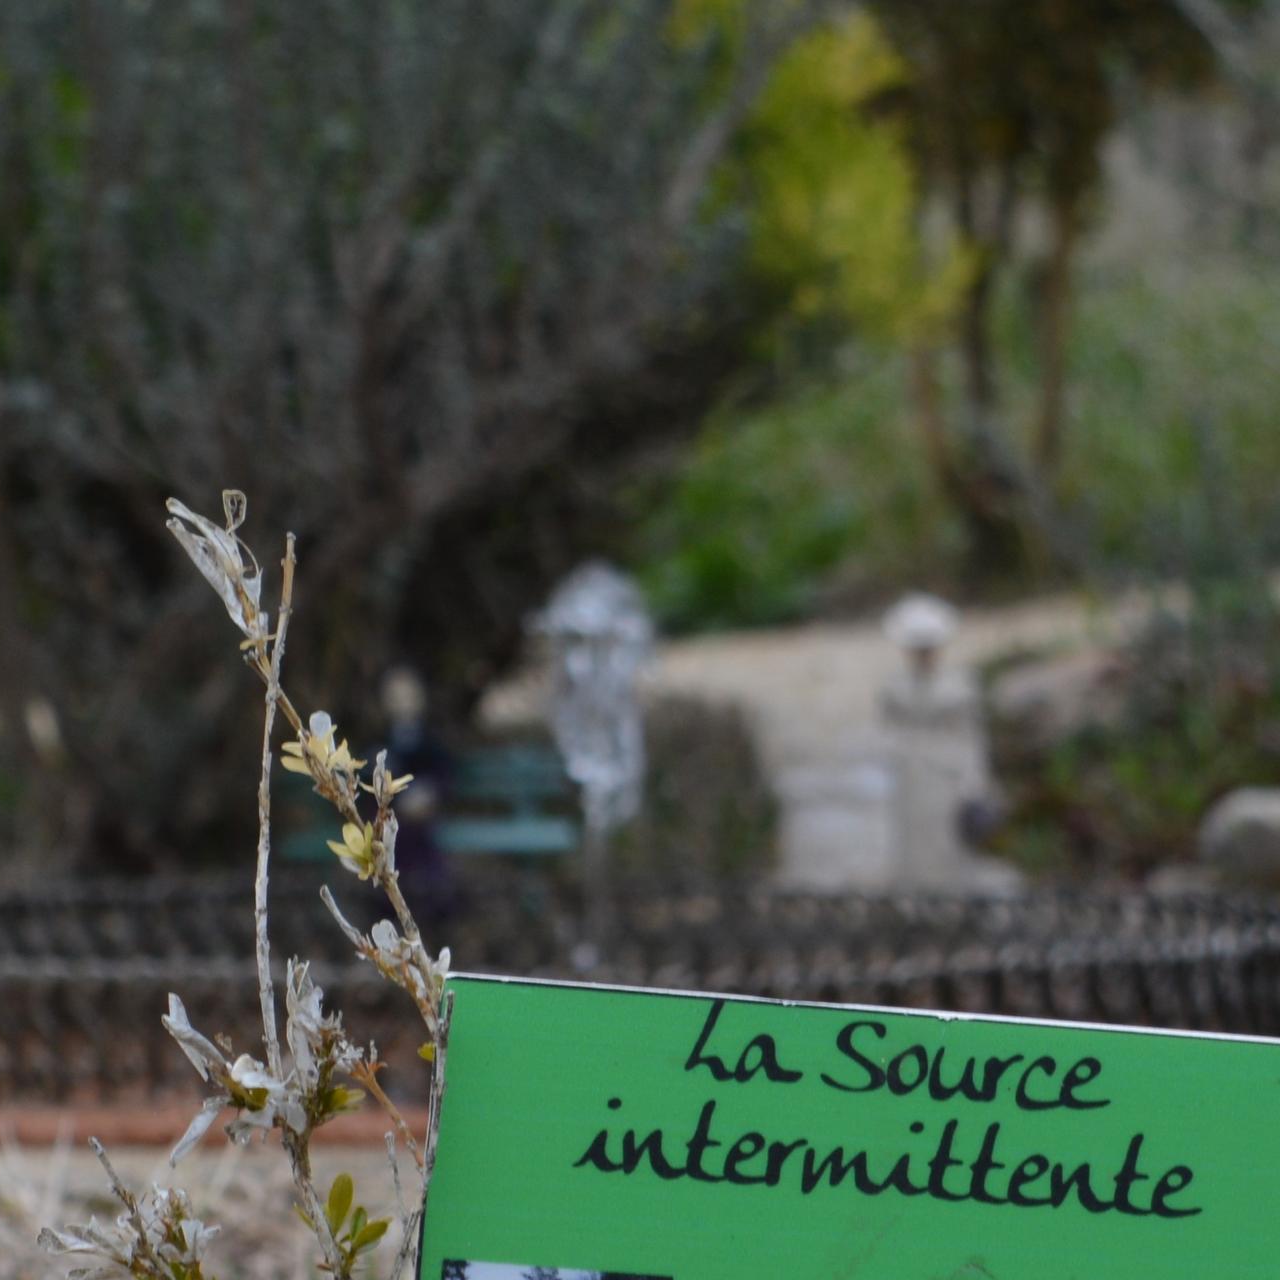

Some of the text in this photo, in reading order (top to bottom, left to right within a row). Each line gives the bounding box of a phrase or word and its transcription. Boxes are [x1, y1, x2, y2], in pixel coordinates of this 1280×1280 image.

[685, 999, 1111, 1110] La Source
[573, 1099, 1203, 1218] intermittente
